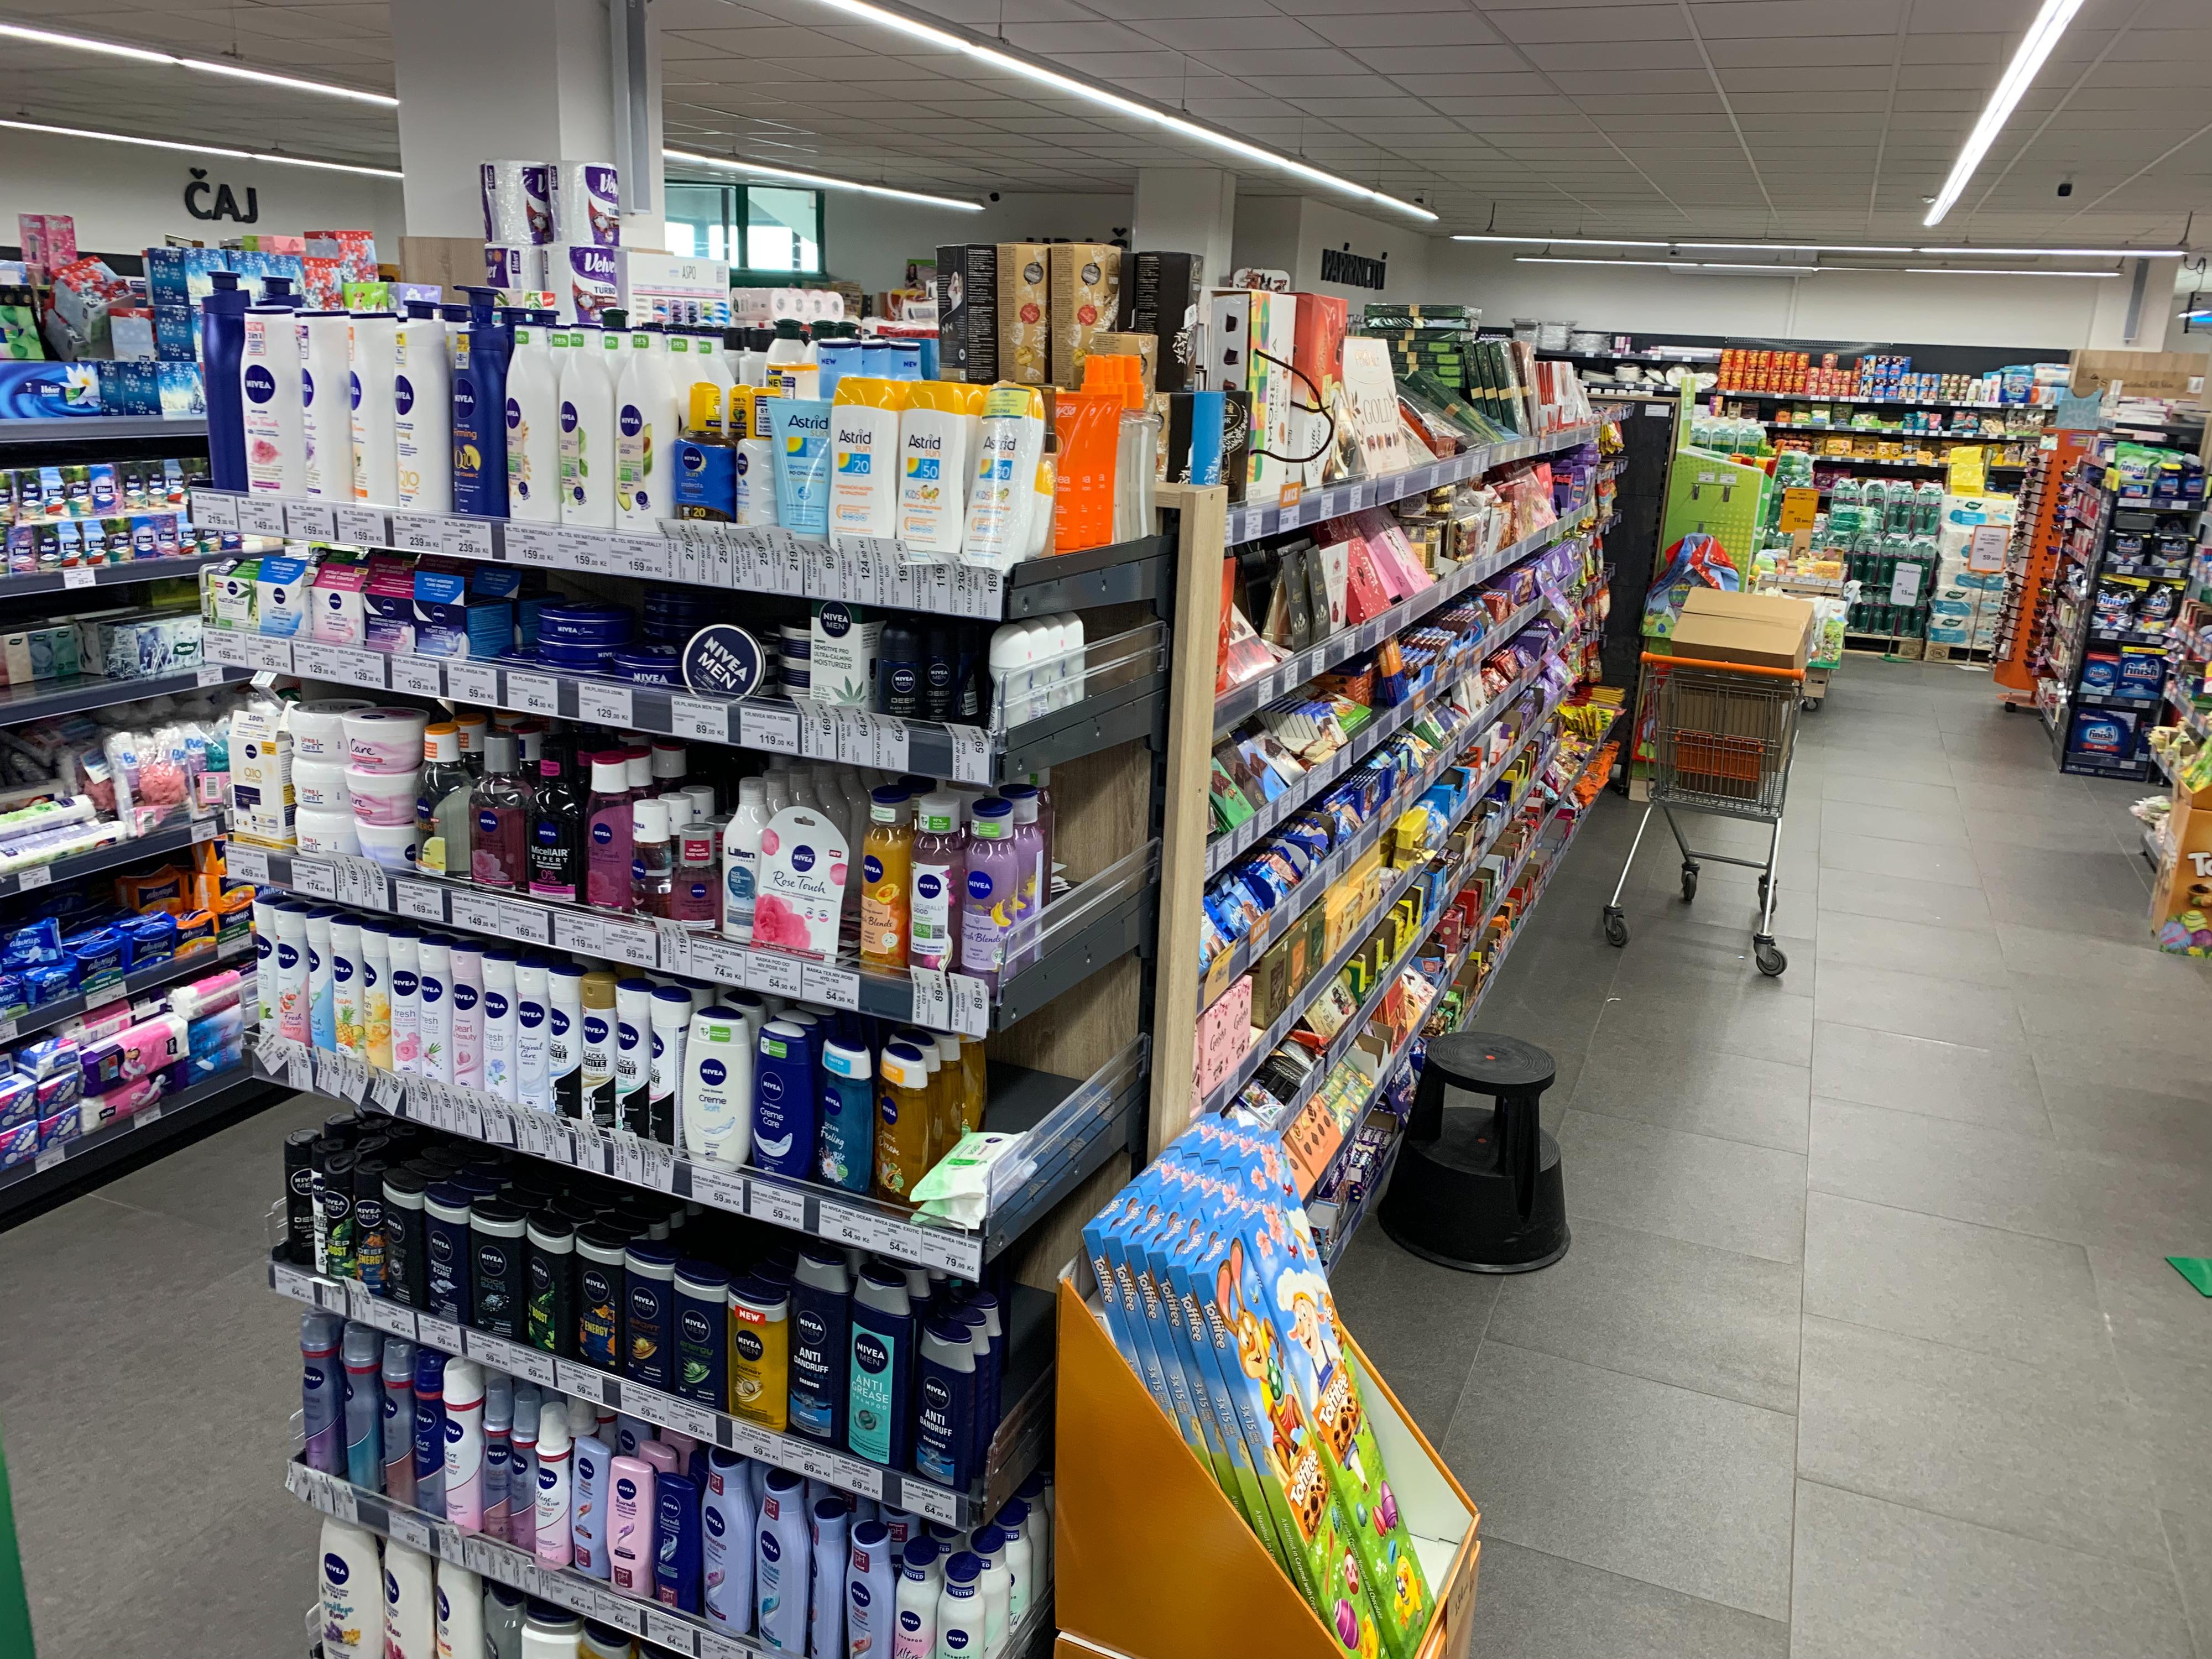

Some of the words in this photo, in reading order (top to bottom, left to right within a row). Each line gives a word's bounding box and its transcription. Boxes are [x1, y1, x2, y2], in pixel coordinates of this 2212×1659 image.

[185, 168, 258, 223] ČAJ
[246, 379, 272, 389] NIVEA
[454, 394, 473, 403] NIVEA
[1363, 398, 1392, 425] GOLD
[788, 415, 828, 431] Astrid
[838, 429, 872, 444] Astrid
[908, 434, 941, 450] Astrid
[854, 460, 868, 473] 20
[923, 465, 938, 478] 50
[1283, 489, 1300, 504] AKCE
[693, 507, 706, 517] 20
[858, 540, 865, 549] Kč
[789, 541, 799, 571] 219,00
[628, 561, 653, 572] 159,00
[860, 549, 870, 581] 124,00
[823, 612, 848, 623] NIVEA
[557, 625, 578, 634] NIVEA
[826, 621, 845, 630] MEN
[813, 644, 837, 654] SENSITIVE
[703, 635, 748, 683] NIVEA
[813, 651, 852, 663] ULTRA-CALMING
[697, 651, 738, 690] MEN
[813, 658, 852, 670] MOISTURIZER
[2125, 663, 2157, 676] finish
[2090, 668, 2111, 677] finish
[696, 724, 716, 735] 89,00
[2089, 729, 2113, 739] finish
[300, 735, 316, 744] Urea
[759, 734, 785, 745] 119,00
[349, 738, 376, 756] Care
[244, 768, 262, 778] Q10
[531, 846, 568, 857] MicellAIR
[728, 847, 755, 859] Lilien
[531, 854, 568, 863] EXPERT
[793, 854, 813, 864] NIVEA
[541, 869, 556, 881] 0%
[773, 870, 795, 888] Rose
[796, 874, 826, 894] Touch
[968, 881, 990, 890] NIVEA
[912, 902, 945, 911] NATURALLY
[868, 915, 893, 928] Blends
[1253, 917, 1267, 938] AKCE
[714, 967, 733, 979] 74,90
[769, 978, 788, 990] 54,90
[973, 981, 980, 989] Kč
[826, 990, 845, 1003] 54,90
[974, 990, 983, 1010] 89,90
[394, 1009, 416, 1018] fresh
[454, 1025, 473, 1034] pearl
[518, 1040, 543, 1051] Original
[763, 1081, 781, 1092] NIVEA
[698, 1094, 727, 1105] Creme
[825, 1097, 840, 1108] NIVEA
[703, 1102, 721, 1113] Soft
[760, 1108, 784, 1121] Creme
[762, 1117, 780, 1129] Care
[824, 1122, 839, 1131] OCEAN
[820, 1126, 844, 1150] Feeling
[713, 1192, 732, 1203] 59,90
[358, 1207, 382, 1215] NIVEA
[773, 1209, 792, 1222] 59,90
[842, 1229, 862, 1241] 54,90
[903, 1226, 919, 1235] EXOTIC
[431, 1238, 451, 1250] NIVEA
[889, 1242, 910, 1254] 54,90
[357, 1246, 385, 1256] DEEP
[358, 1254, 385, 1265] ENERGY
[481, 1253, 504, 1264] NIVEA
[945, 1256, 966, 1269] 79,00
[967, 1264, 975, 1272] Kč
[430, 1259, 452, 1274] PROTECT
[532, 1264, 548, 1278] NIVEA
[480, 1275, 505, 1285] ROCK
[585, 1277, 607, 1290] NIVEA
[1093, 1254, 1114, 1304] Toffifee
[481, 1282, 506, 1292] SALTS
[1114, 1262, 1136, 1312] Toffifee
[634, 1295, 655, 1307] NIVEA
[1136, 1271, 1157, 1320] Toffifee
[1159, 1277, 1181, 1328] Toffifee
[531, 1309, 548, 1324] BOOST
[739, 1311, 761, 1322] NEW
[1180, 1292, 1203, 1343] Toffifee
[584, 1321, 609, 1338] ENERGY
[685, 1318, 707, 1330] NIVEA
[800, 1317, 823, 1332] NIVEA
[1203, 1299, 1226, 1350] Toffifee
[738, 1335, 761, 1350] NIVEA
[739, 1344, 759, 1355] MEN
[799, 1348, 821, 1363] ANTI
[857, 1342, 885, 1361] NIVEA
[794, 1354, 829, 1374] DANDRUFF
[859, 1354, 880, 1366] MEN
[736, 1364, 763, 1376] ENERGY
[855, 1374, 883, 1392] ANTI
[852, 1380, 889, 1404] GREASE
[926, 1384, 947, 1398] NIVEA
[852, 1392, 888, 1411] SHAMPOO
[1318, 1371, 1349, 1428] Toffifee
[925, 1409, 946, 1426] ANTI
[920, 1416, 952, 1437] DANDRUFF
[923, 1434, 946, 1449] SHAMPOO
[579, 1464, 593, 1474] NIVEA
[803, 1462, 822, 1475] 89,00
[1289, 1447, 1319, 1507] Toffifee
[852, 1479, 870, 1492] 89,00
[924, 1504, 943, 1518] 64,00
[706, 1514, 723, 1530] NIVEA
[1255, 1515, 1270, 1547] Hazelnut
[761, 1539, 778, 1554] NIVEA
[1281, 1524, 1295, 1557] Hazelnut
[1293, 1562, 1309, 1591] Caramel
[1303, 1589, 1313, 1601] with
[325, 1563, 346, 1577] NIVEA
[904, 1569, 925, 1581] TESTED
[1348, 1536, 1359, 1560] Creamy
[1357, 1557, 1367, 1580] Nougat
[1368, 1587, 1383, 1619] Chocolate
[852, 1587, 868, 1600] NIVEA
[952, 1588, 974, 1597] TESTED
